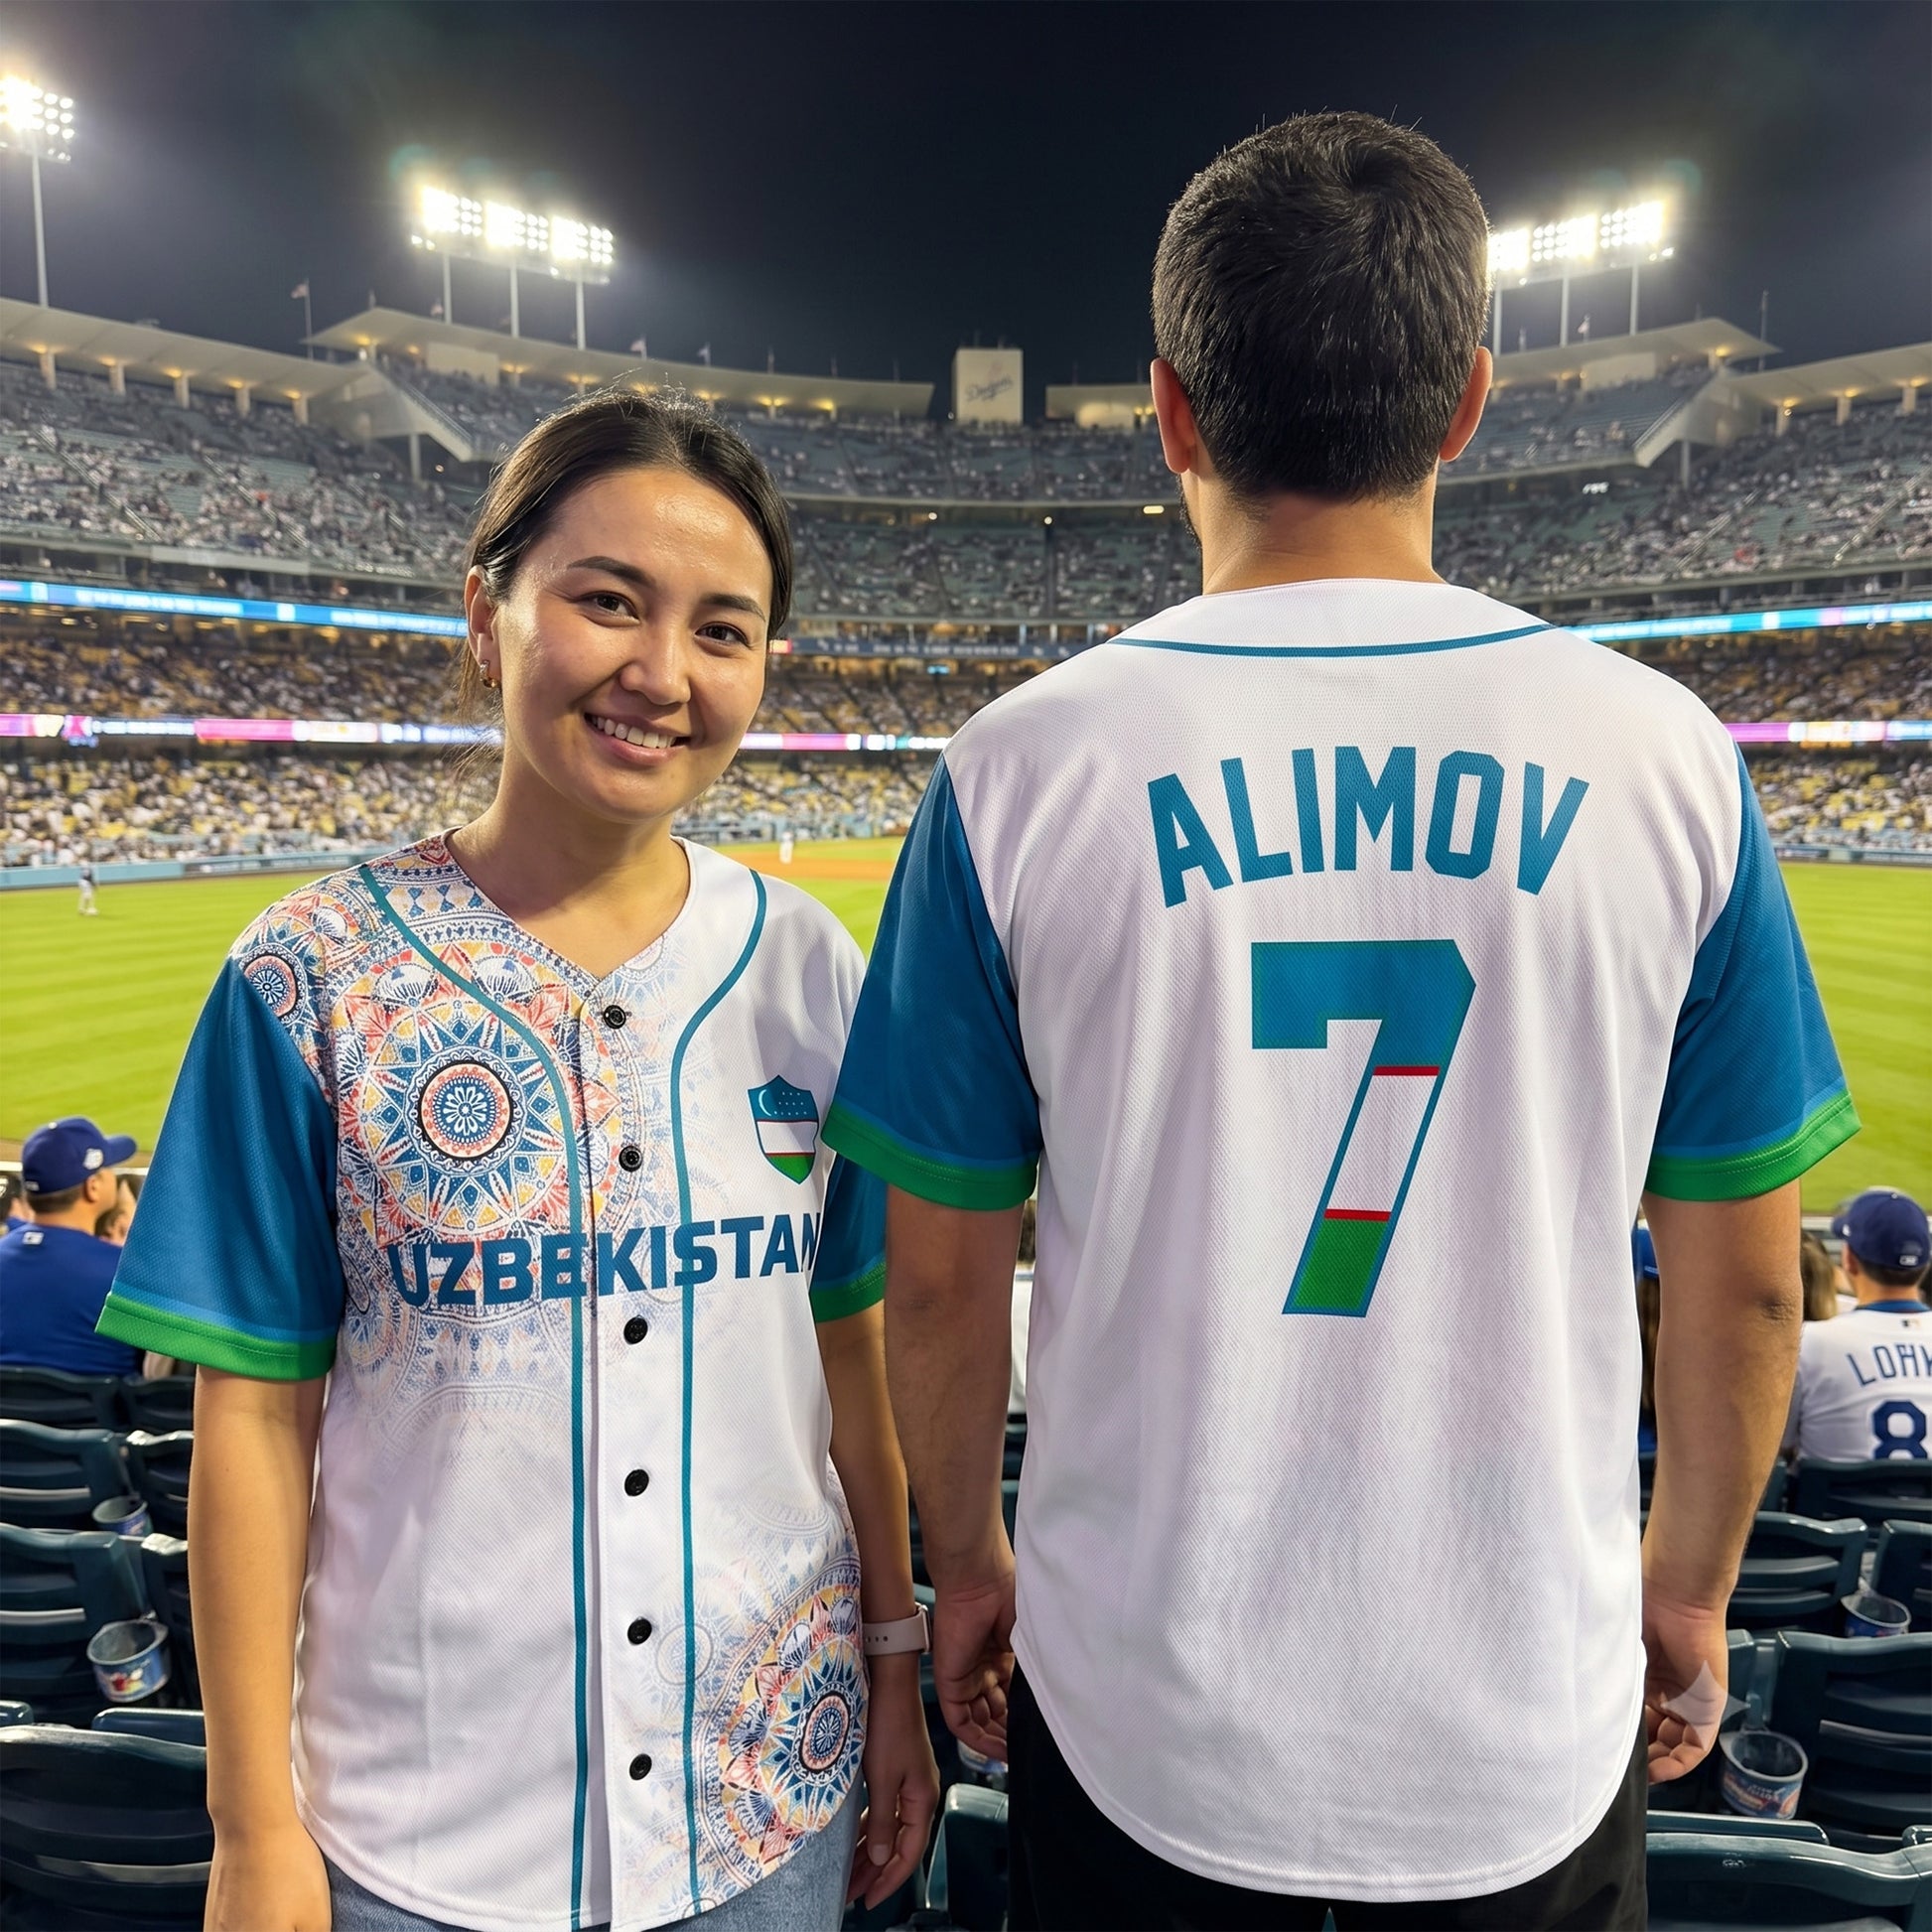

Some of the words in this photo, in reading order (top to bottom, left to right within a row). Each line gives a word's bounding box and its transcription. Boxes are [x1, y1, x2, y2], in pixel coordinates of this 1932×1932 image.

[1148, 746, 1589, 908] ALIMOV
[1251, 939, 1476, 1317] 7
[1872, 1400, 1928, 1459] 8
